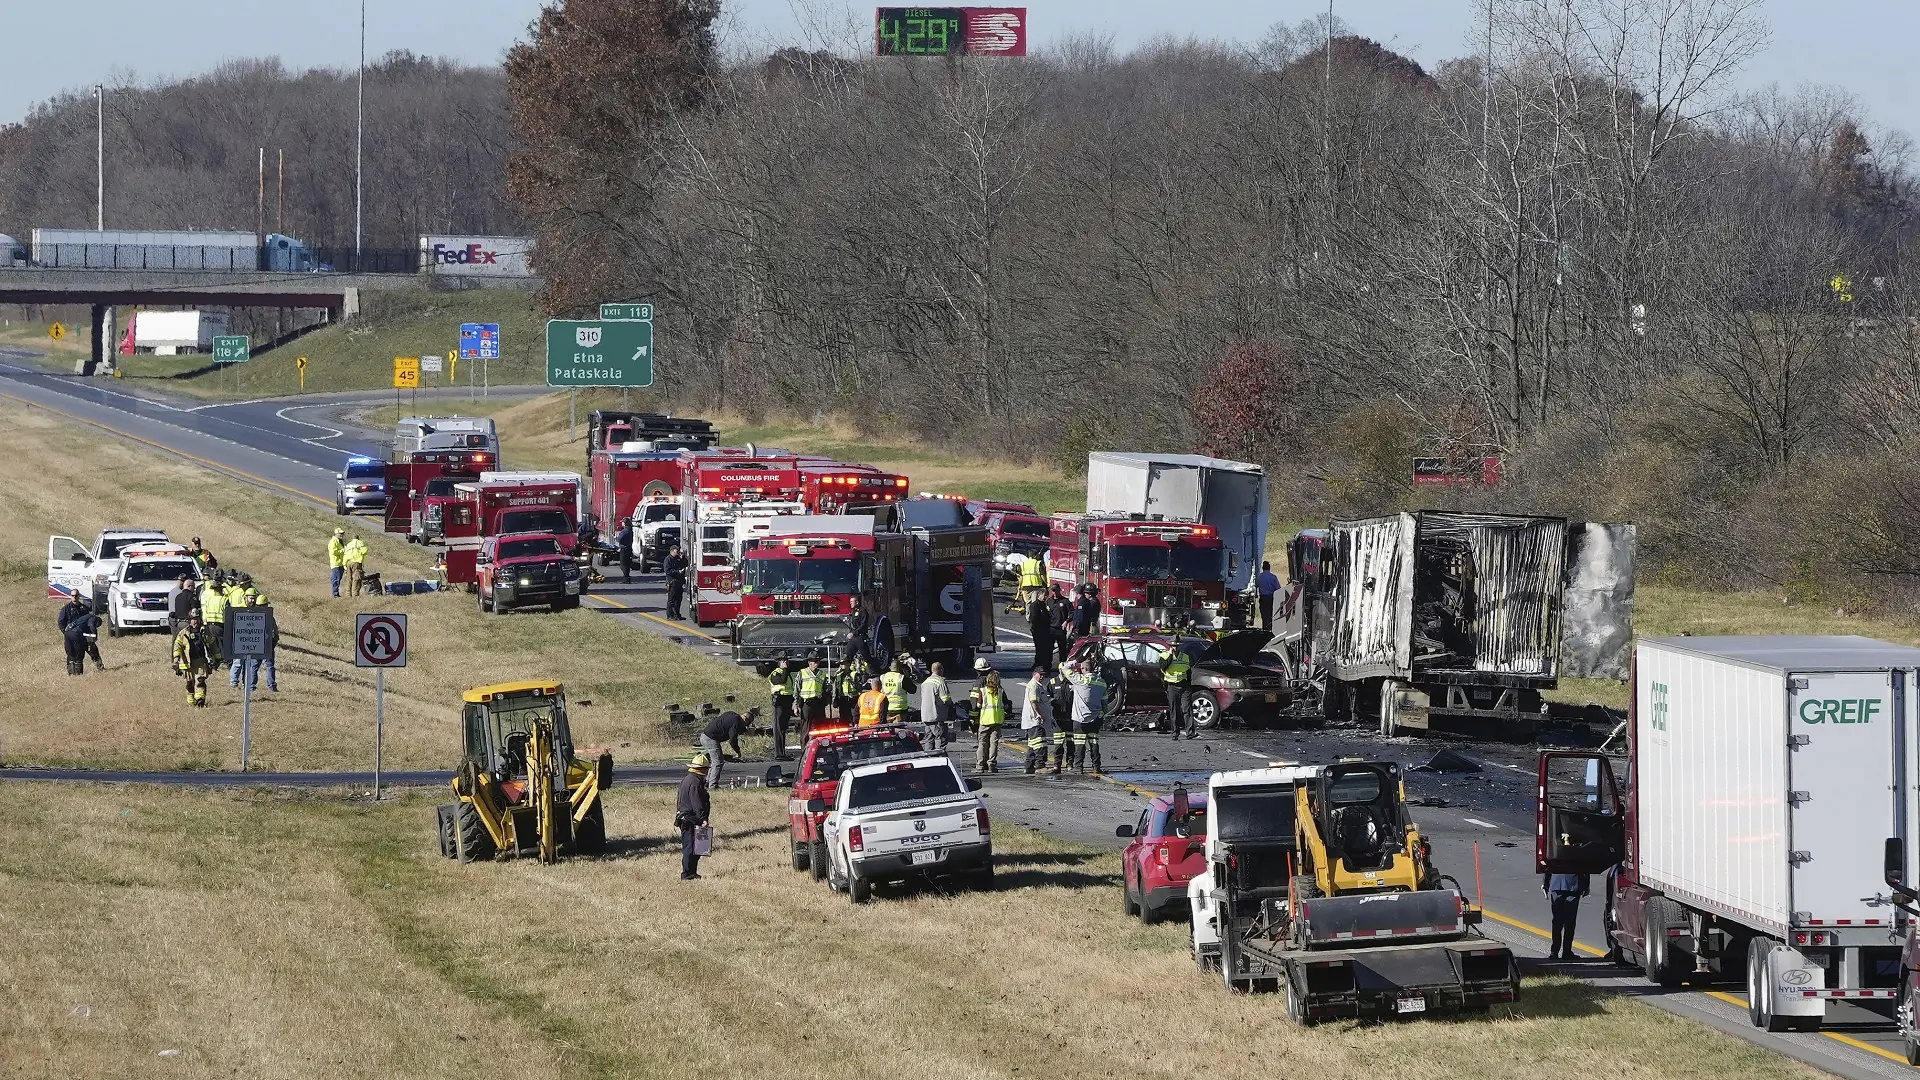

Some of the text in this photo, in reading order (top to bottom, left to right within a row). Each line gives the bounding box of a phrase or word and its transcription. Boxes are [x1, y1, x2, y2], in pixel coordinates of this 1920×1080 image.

[904, 9, 933, 17] DIESEL
[433, 244, 497, 264] FedEx
[604, 307, 649, 319] EXIT 118
[580, 331, 599, 342] 310
[216, 347, 231, 357] 118
[573, 353, 603, 364] Etna
[399, 371, 415, 380] 45
[555, 367, 622, 380] Pataskala
[509, 497, 550, 506] SUPPORT 401
[1651, 680, 1668, 731] GREIF
[1800, 699, 1881, 724] GREIF
[901, 834, 941, 844] PUCO
